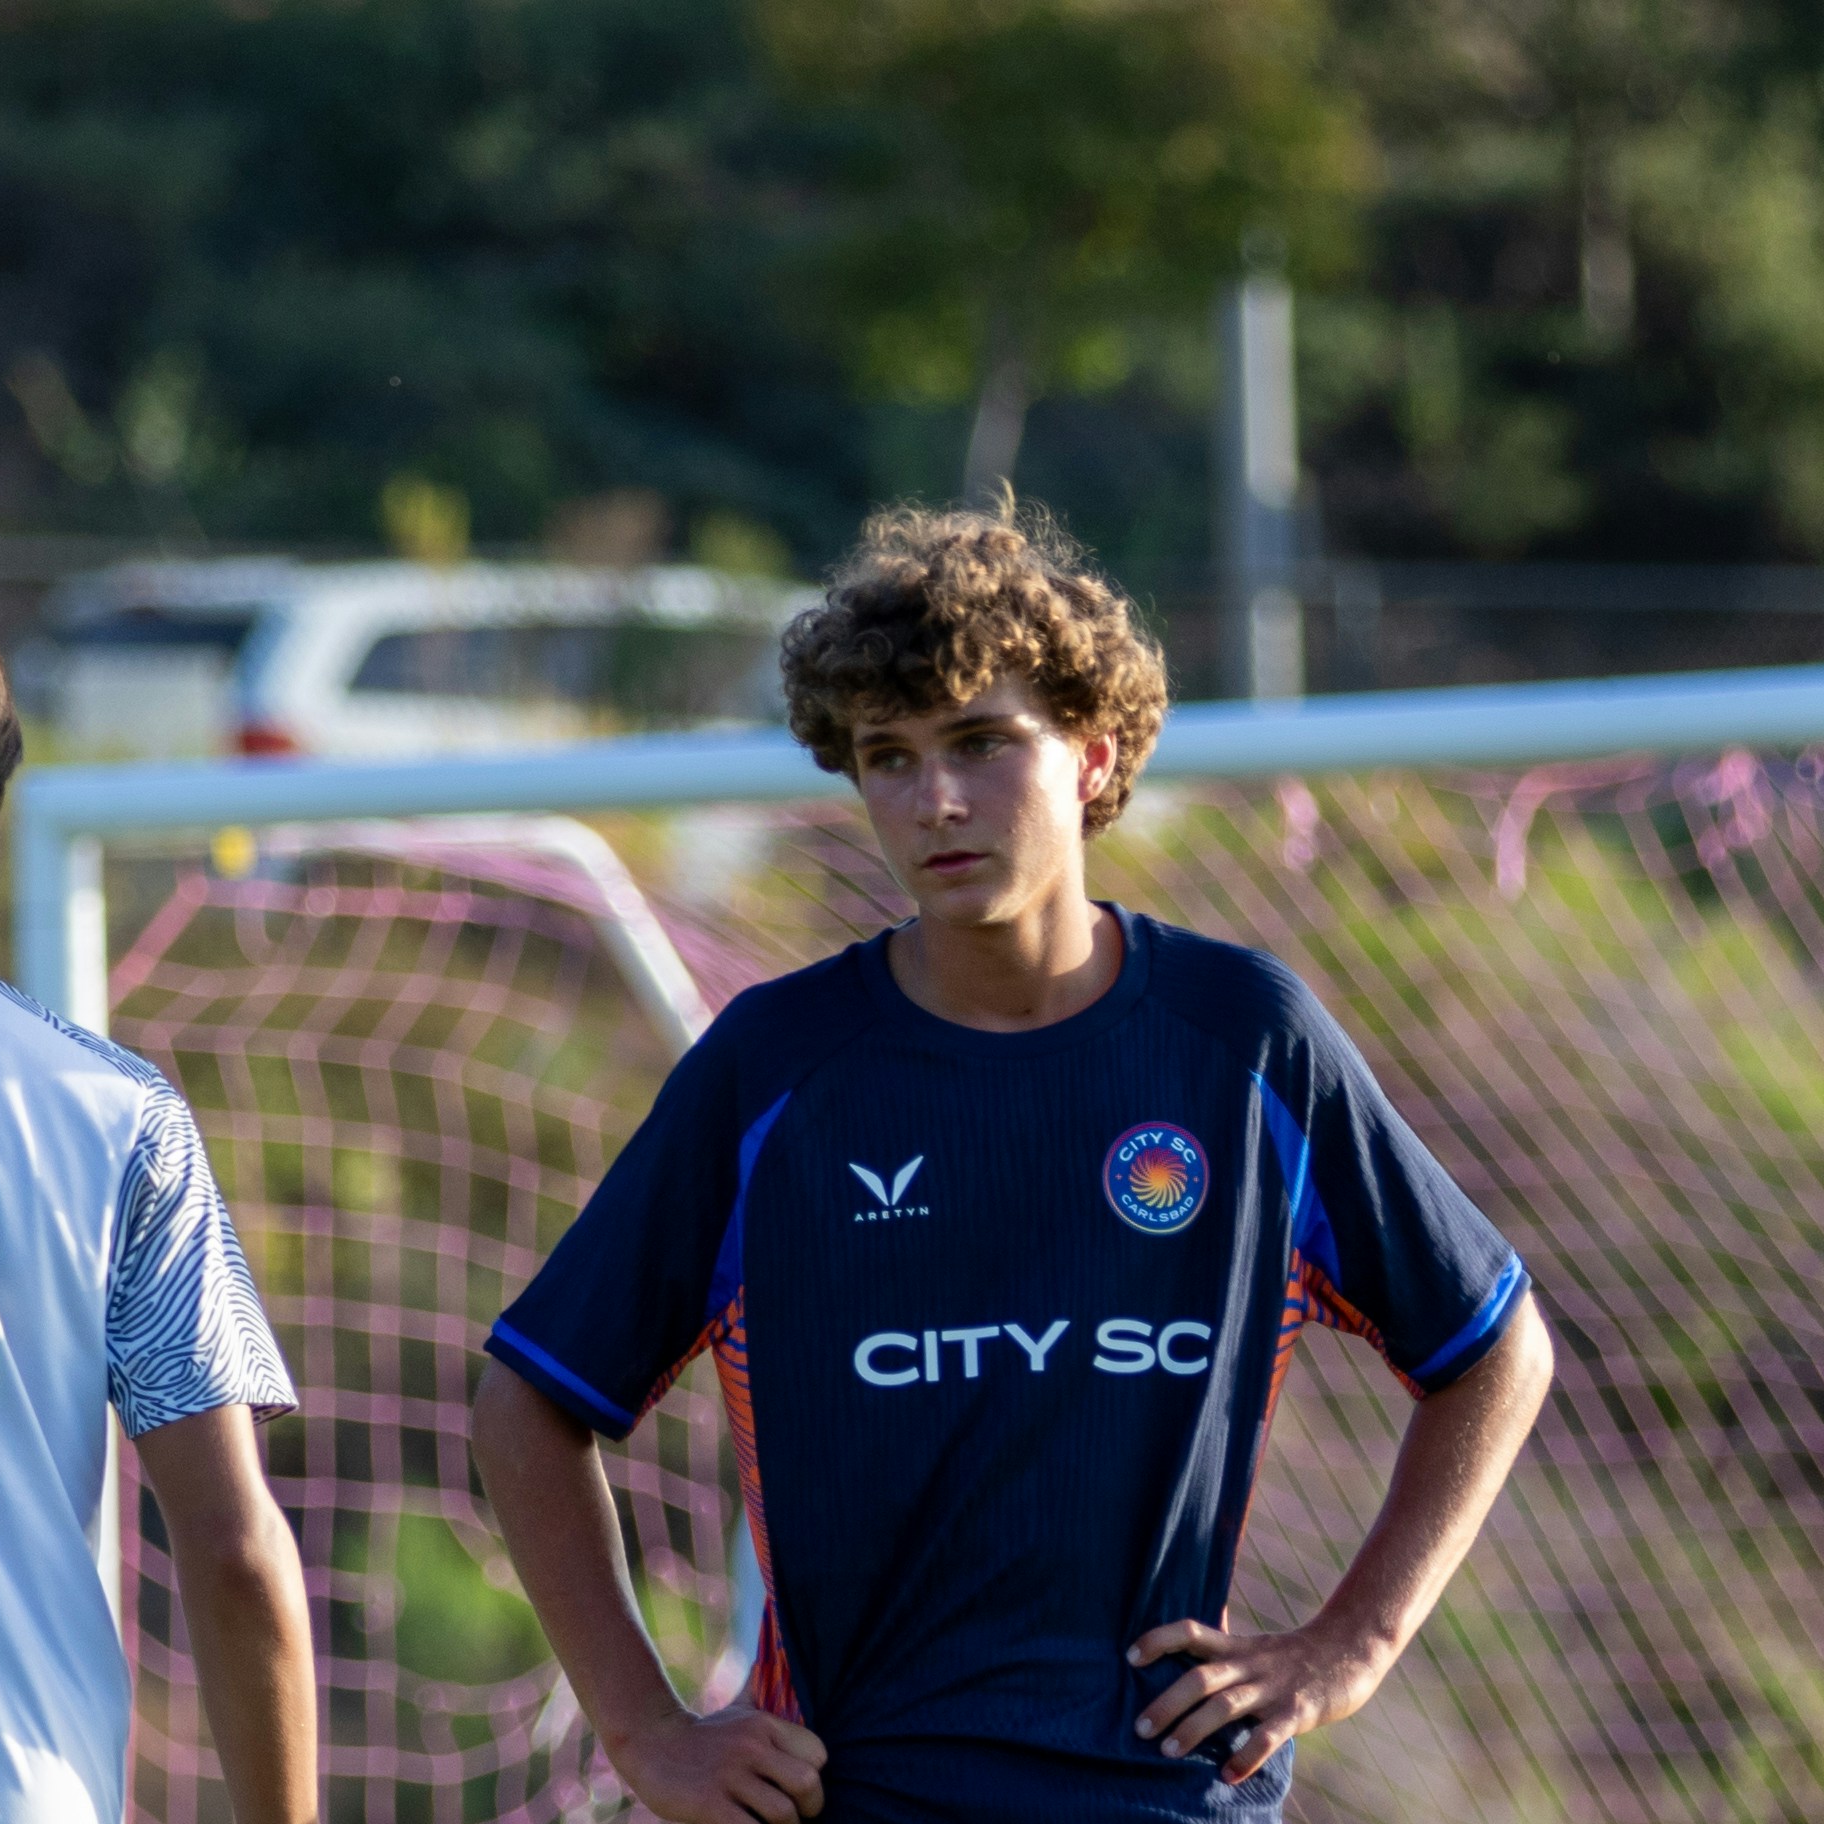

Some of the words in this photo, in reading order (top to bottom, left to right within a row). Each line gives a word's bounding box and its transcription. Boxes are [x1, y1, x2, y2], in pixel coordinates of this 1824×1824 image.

[1119, 1131, 1164, 1162] CITY
[1170, 1136, 1197, 1164] SC
[854, 1206, 930, 1222] ARETYN
[1121, 1194, 1194, 1222] CARLSBAD
[854, 1320, 1071, 1386] CITY
[1093, 1318, 1211, 1375] SC
